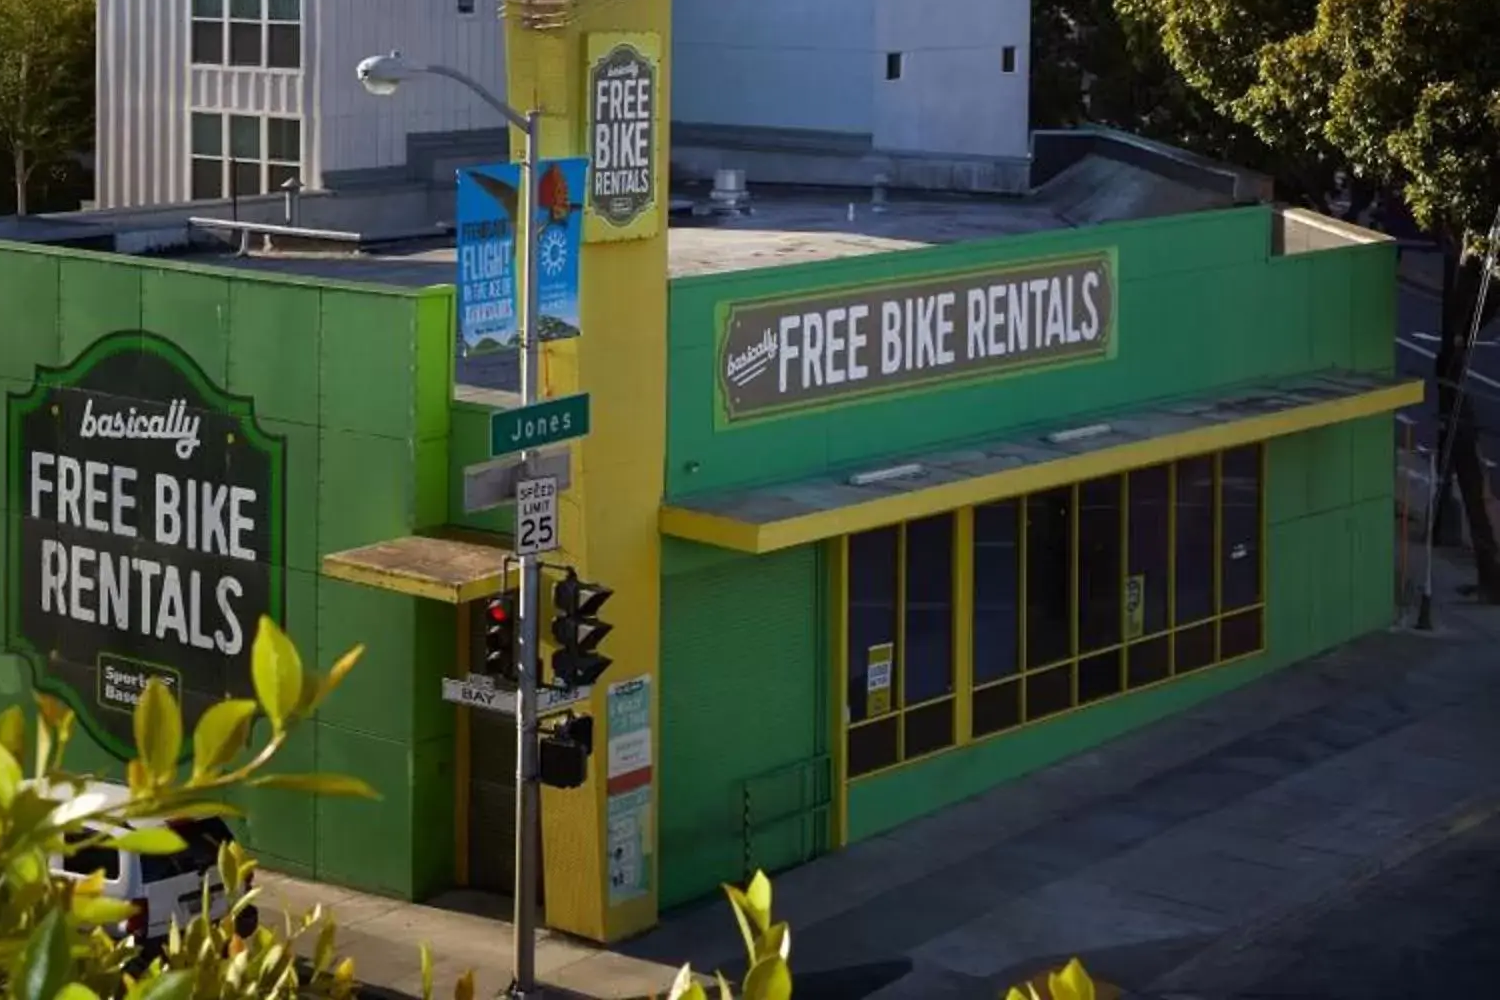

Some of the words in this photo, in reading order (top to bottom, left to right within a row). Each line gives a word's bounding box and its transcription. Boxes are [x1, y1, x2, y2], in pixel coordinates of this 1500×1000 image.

[596, 79, 649, 120] FREE
[596, 121, 649, 168] BIKE
[595, 169, 649, 195] RENTALS
[727, 327, 778, 376] basically
[778, 305, 869, 393] FREE
[881, 291, 955, 375] BIKE
[967, 270, 1100, 360] RENTALS
[80, 399, 200, 458] basically
[512, 412, 572, 441] Jones
[30, 451, 138, 537] FREE
[155, 474, 256, 561] BIKE
[520, 485, 554, 500] SPEED
[523, 501, 550, 515] LIMIT
[520, 516, 553, 546] 25
[41, 540, 244, 655] RENTALS
[105, 665, 148, 688] Sport
[461, 688, 496, 705] BAY
